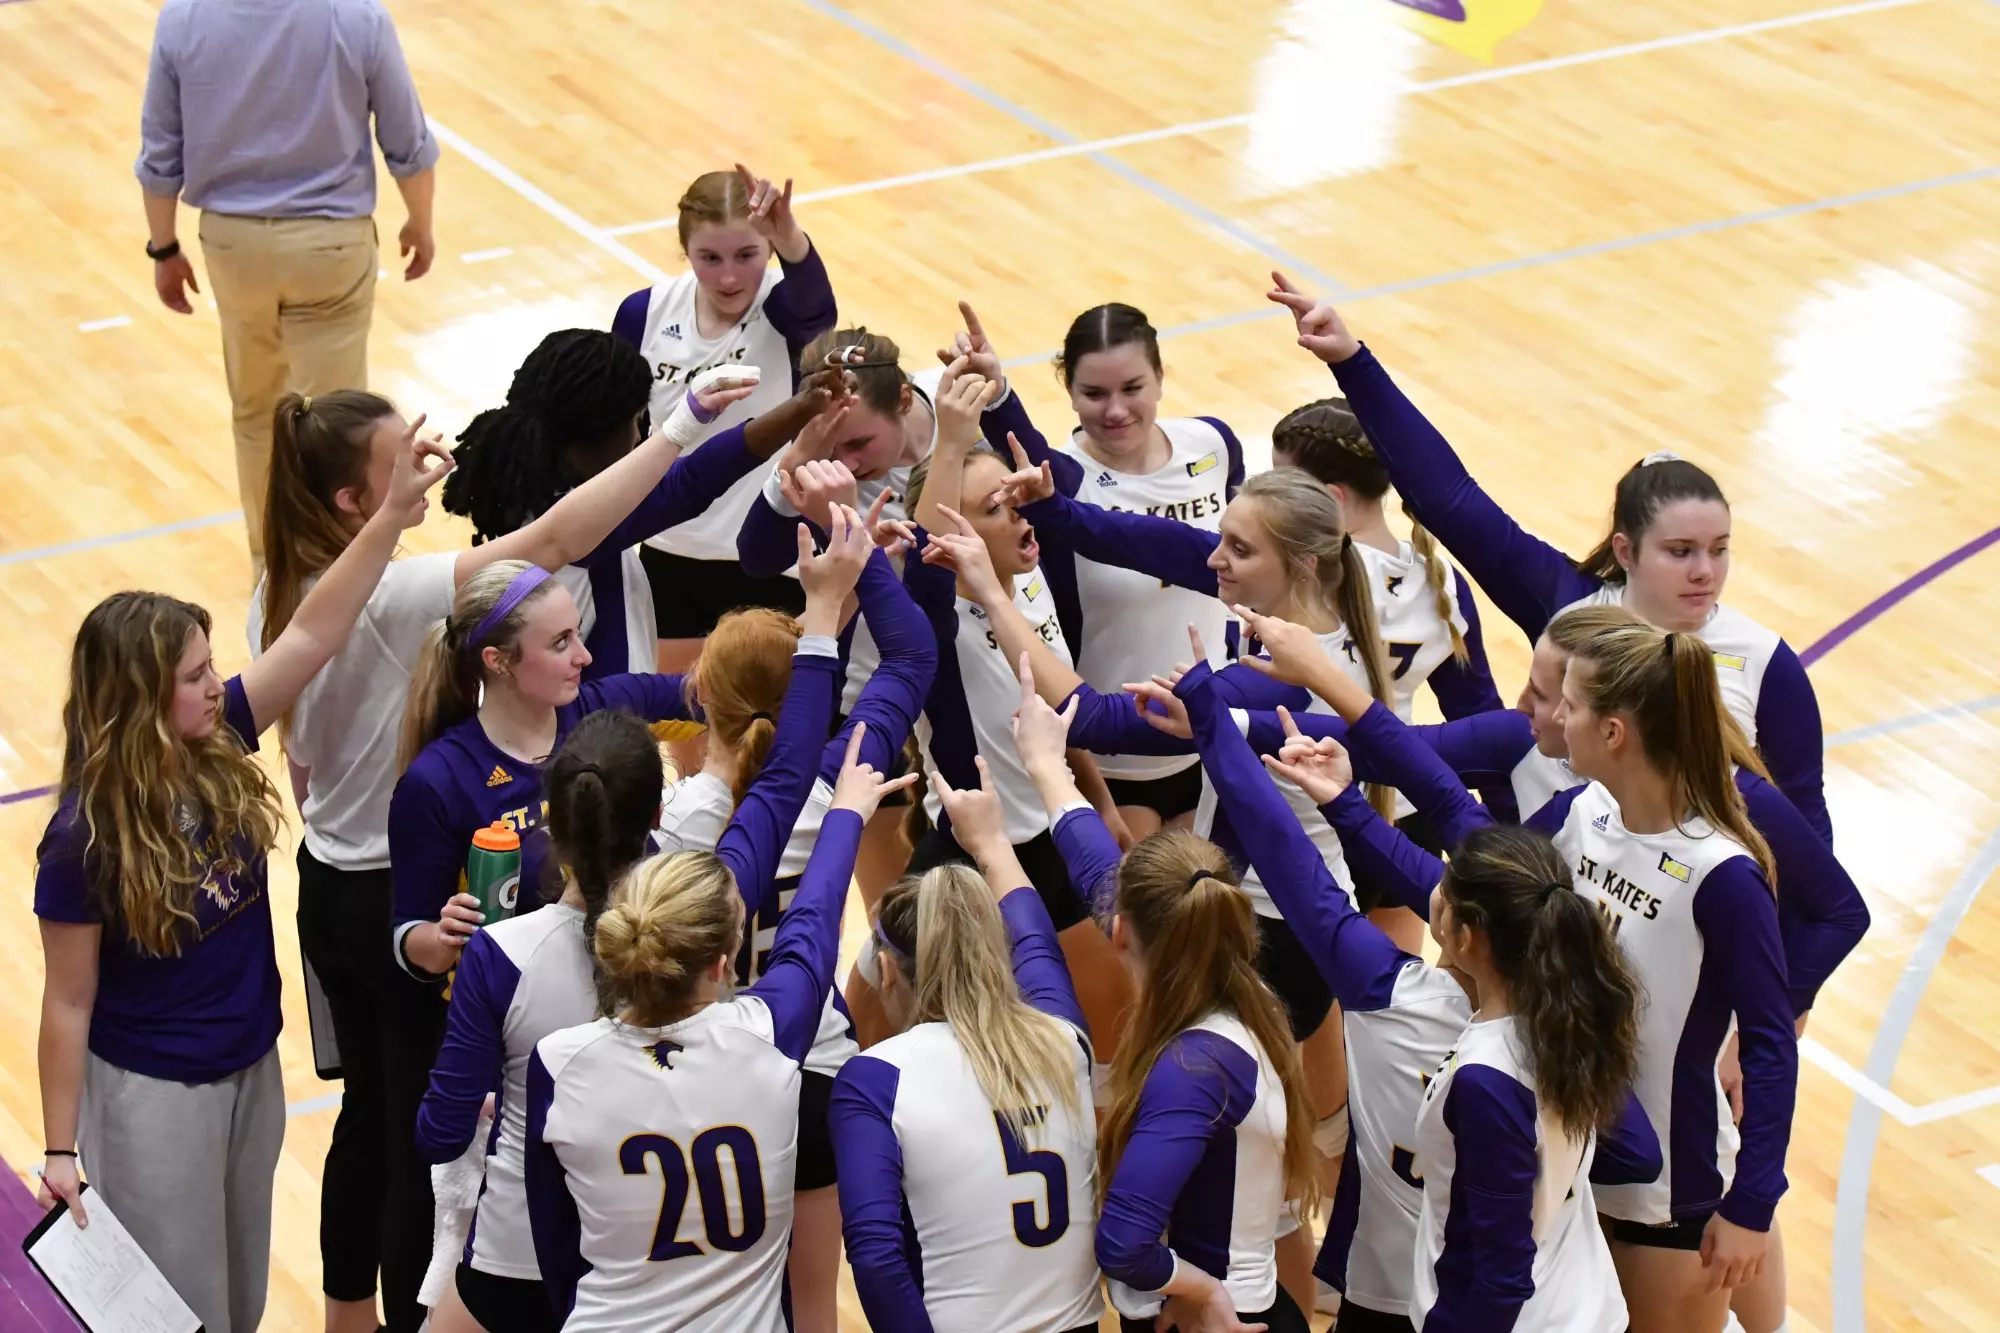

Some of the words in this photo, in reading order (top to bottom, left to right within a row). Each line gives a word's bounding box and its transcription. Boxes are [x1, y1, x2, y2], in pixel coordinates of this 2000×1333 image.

[655, 362, 682, 384] ST.
[486, 774, 514, 788] adidas
[1577, 854, 1598, 885] ST.
[1602, 869, 1662, 920] KATE'S
[617, 1123, 767, 1262] 20
[992, 1102, 1071, 1248] 5
